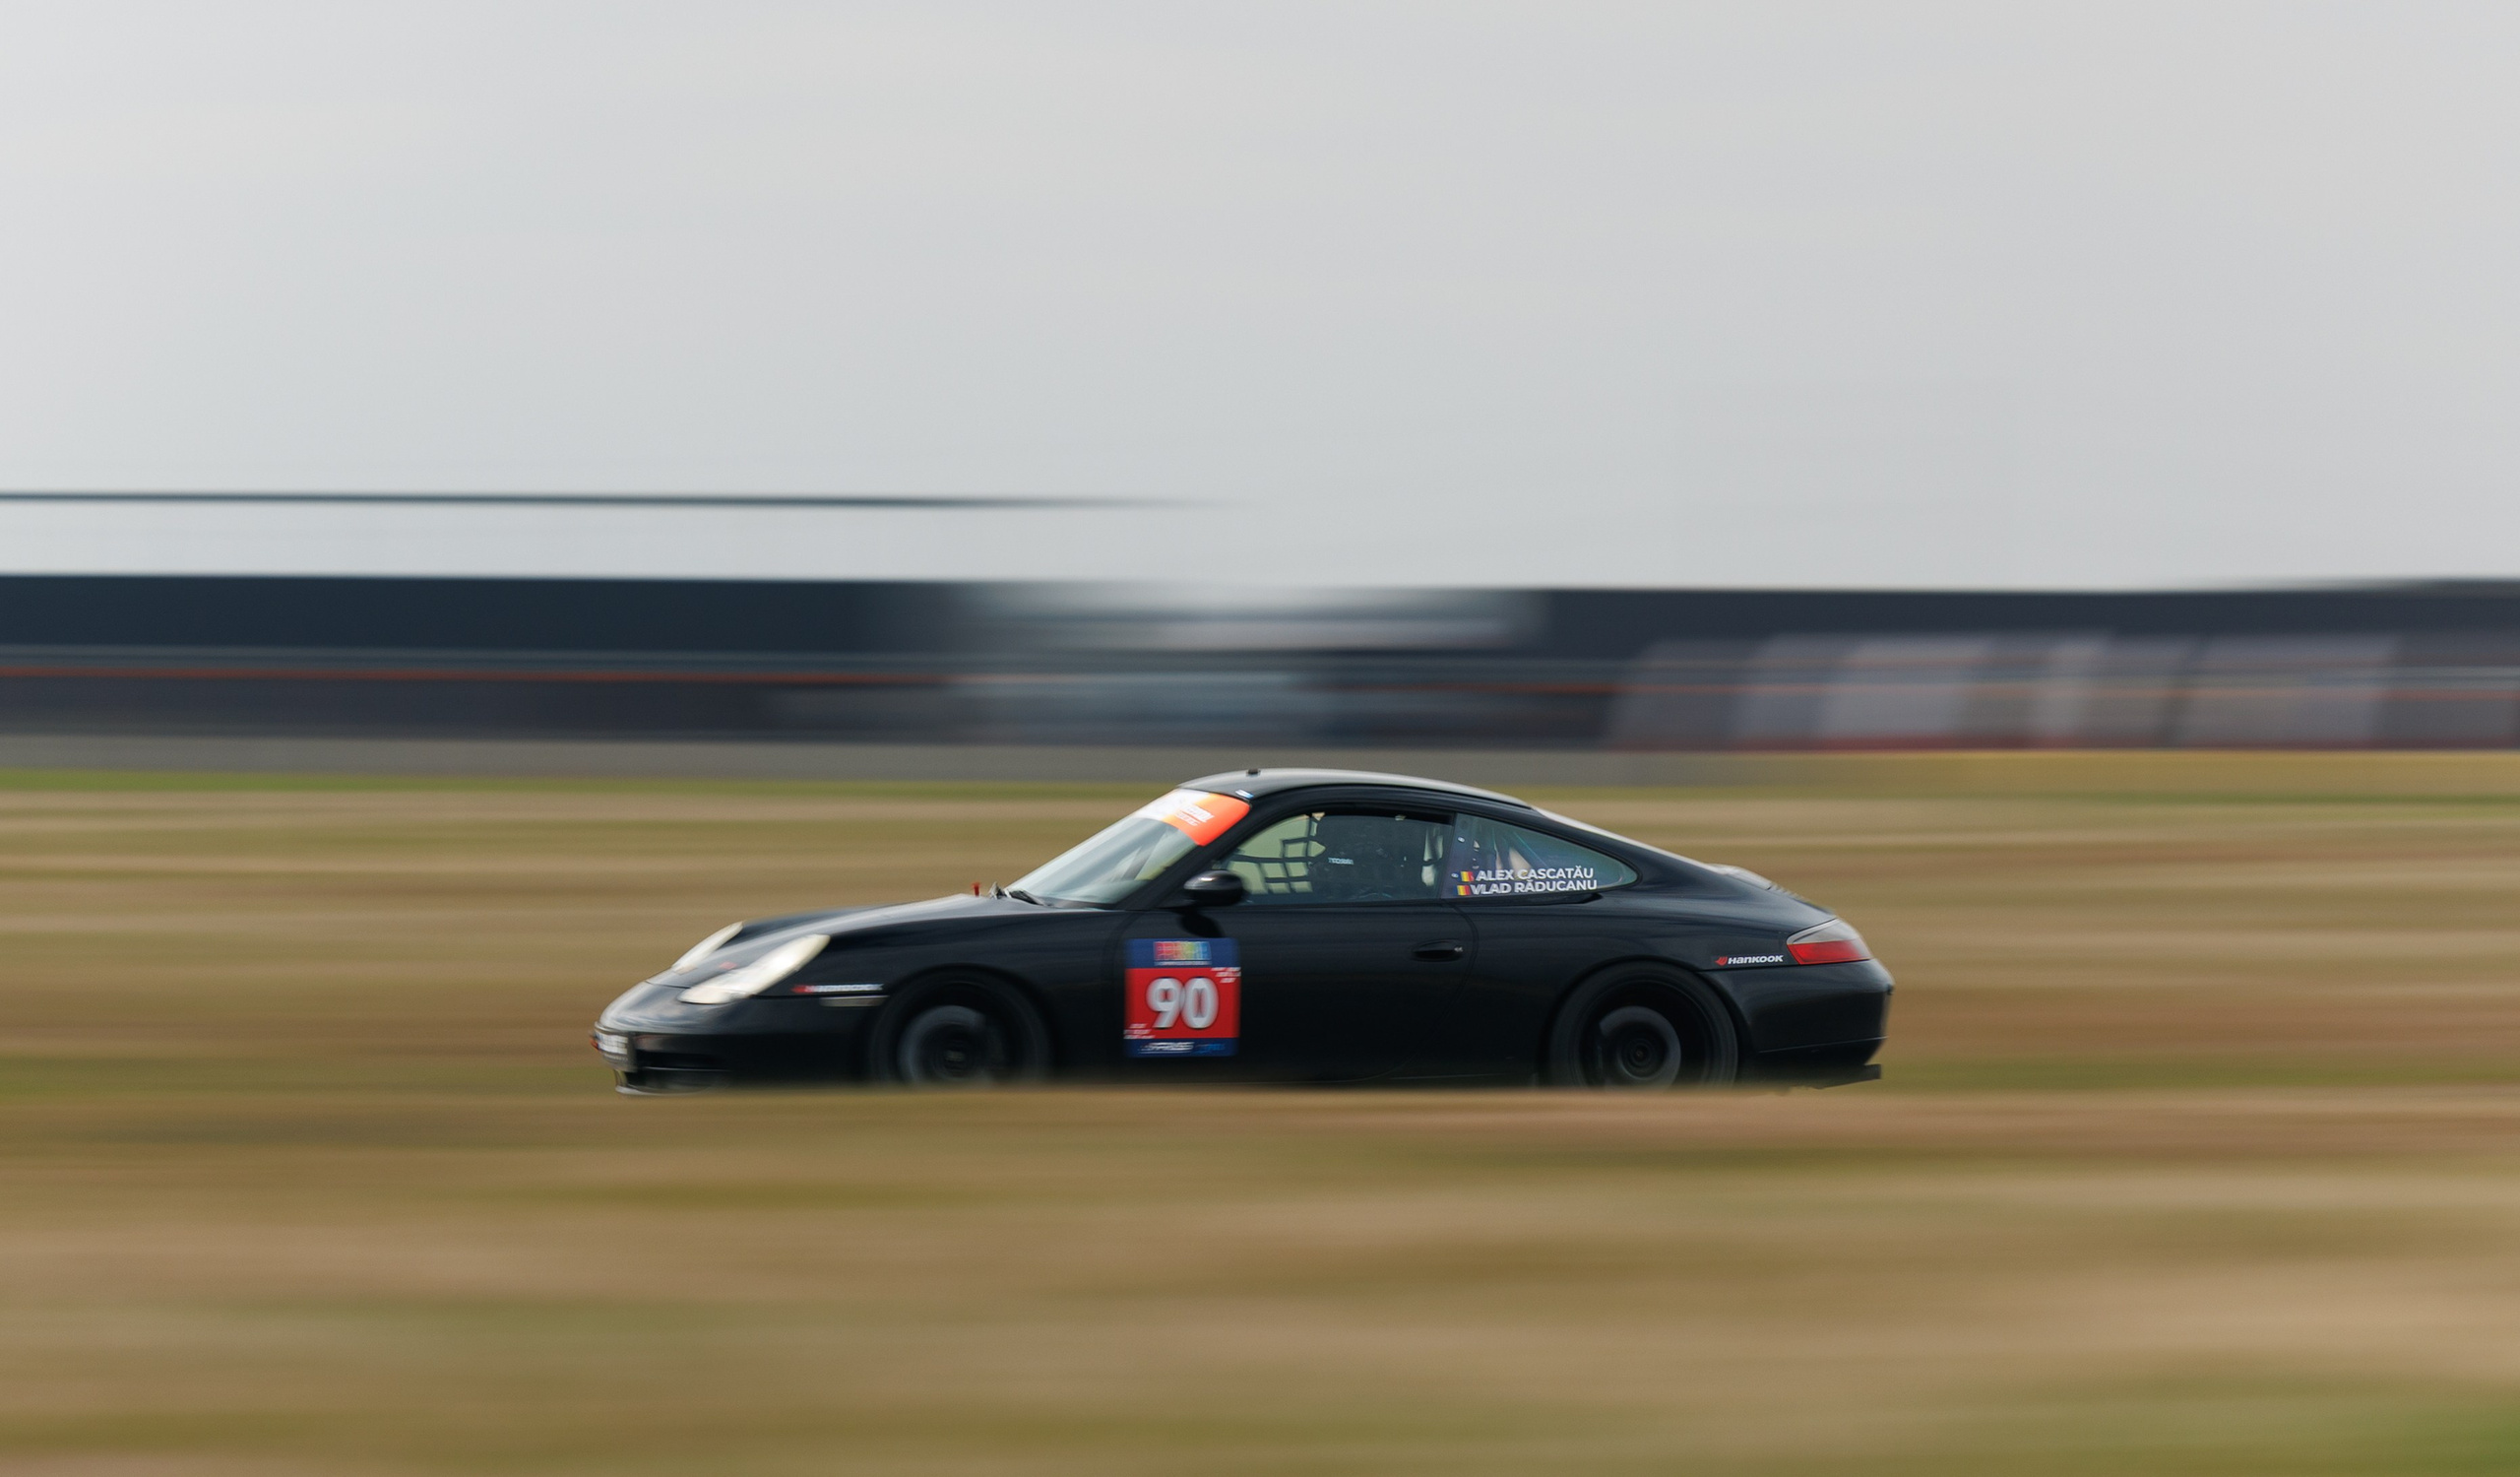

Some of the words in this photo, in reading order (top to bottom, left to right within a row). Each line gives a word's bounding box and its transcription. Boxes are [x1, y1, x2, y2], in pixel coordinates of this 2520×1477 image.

[1476, 869, 1514, 881] ALEX
[1517, 867, 1594, 880] CASCATĂU
[1471, 883, 1511, 895] VLAD
[1514, 879, 1598, 893] RĂDUCANU
[1146, 977, 1219, 1029] 90
